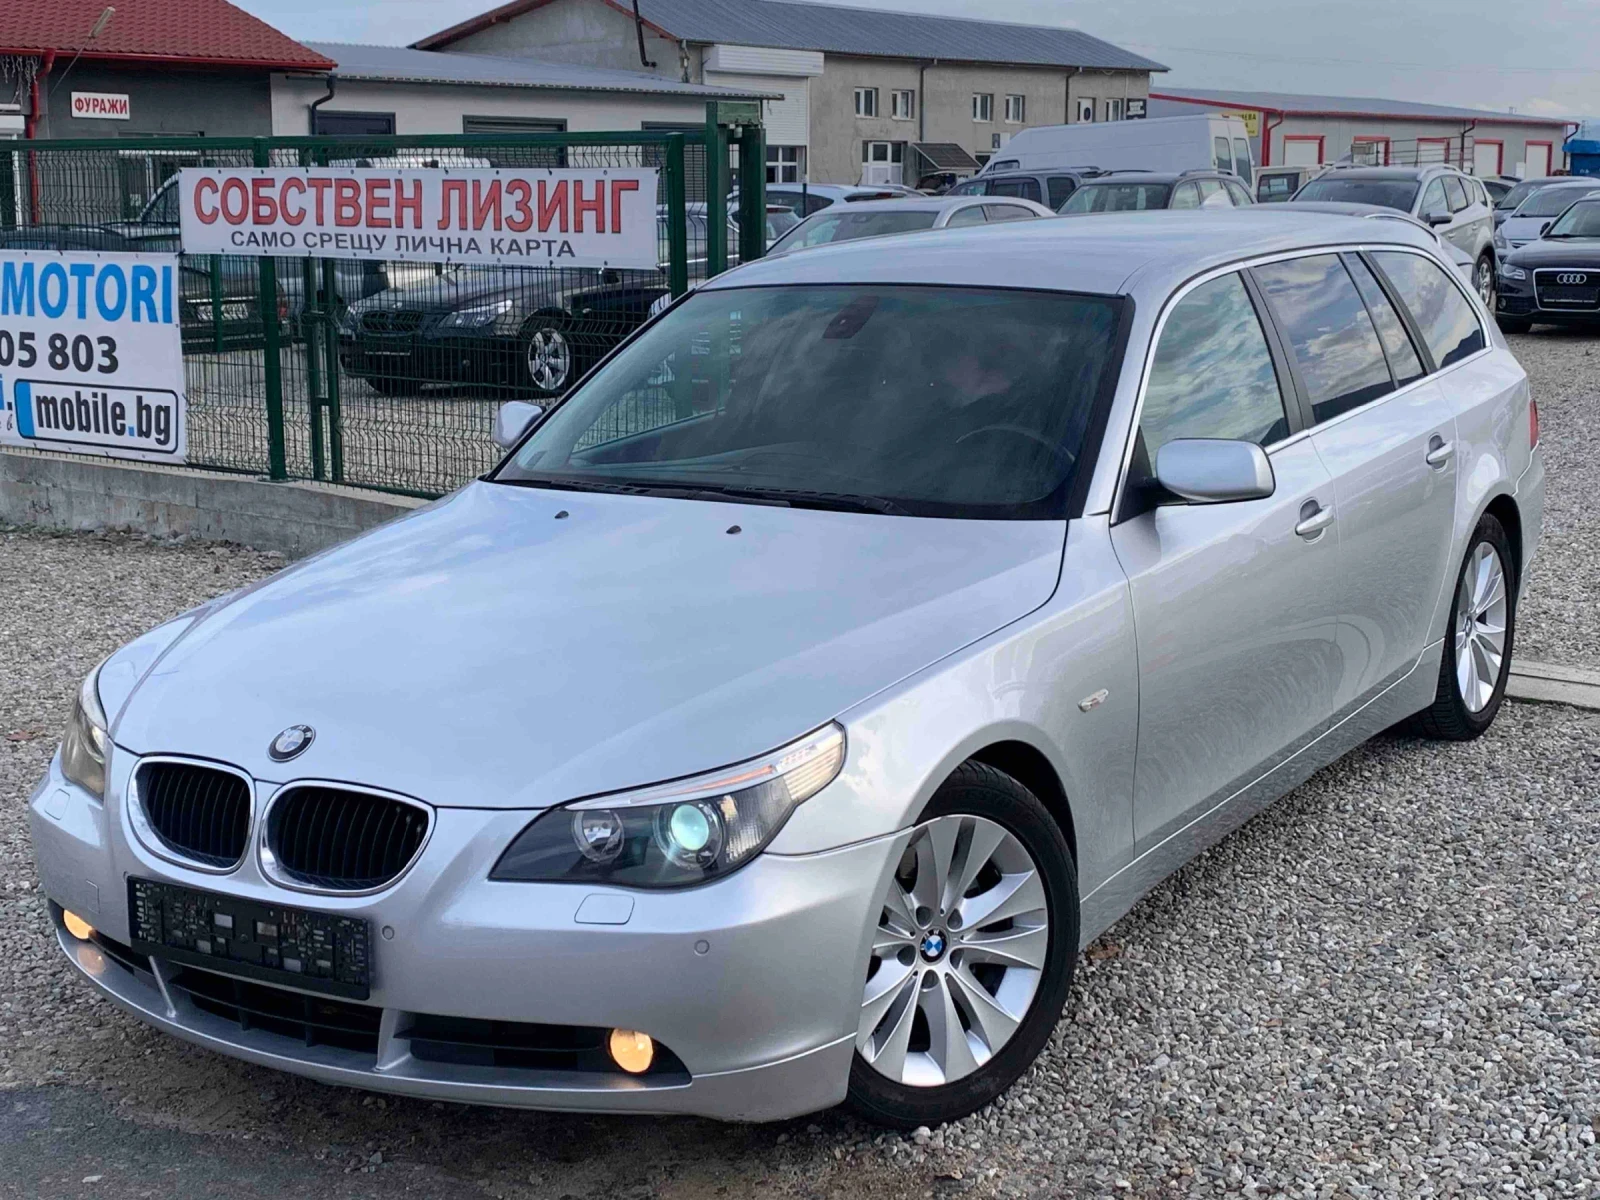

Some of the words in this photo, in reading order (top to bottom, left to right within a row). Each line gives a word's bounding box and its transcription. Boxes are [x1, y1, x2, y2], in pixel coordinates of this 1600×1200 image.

[74, 97, 128, 115] ФУРАЖИ
[193, 176, 423, 230] СОБСТВЕН
[437, 178, 640, 234] ЛИЗИНГ
[231, 230, 296, 248] САМО
[303, 232, 387, 252] СРЕЩУ
[394, 235, 482, 255] ЛИЧНА
[490, 237, 576, 258] КАРТА
[1, 261, 173, 324] MOTORI
[48, 333, 119, 374] 803
[35, 390, 171, 446] mobile.bg
